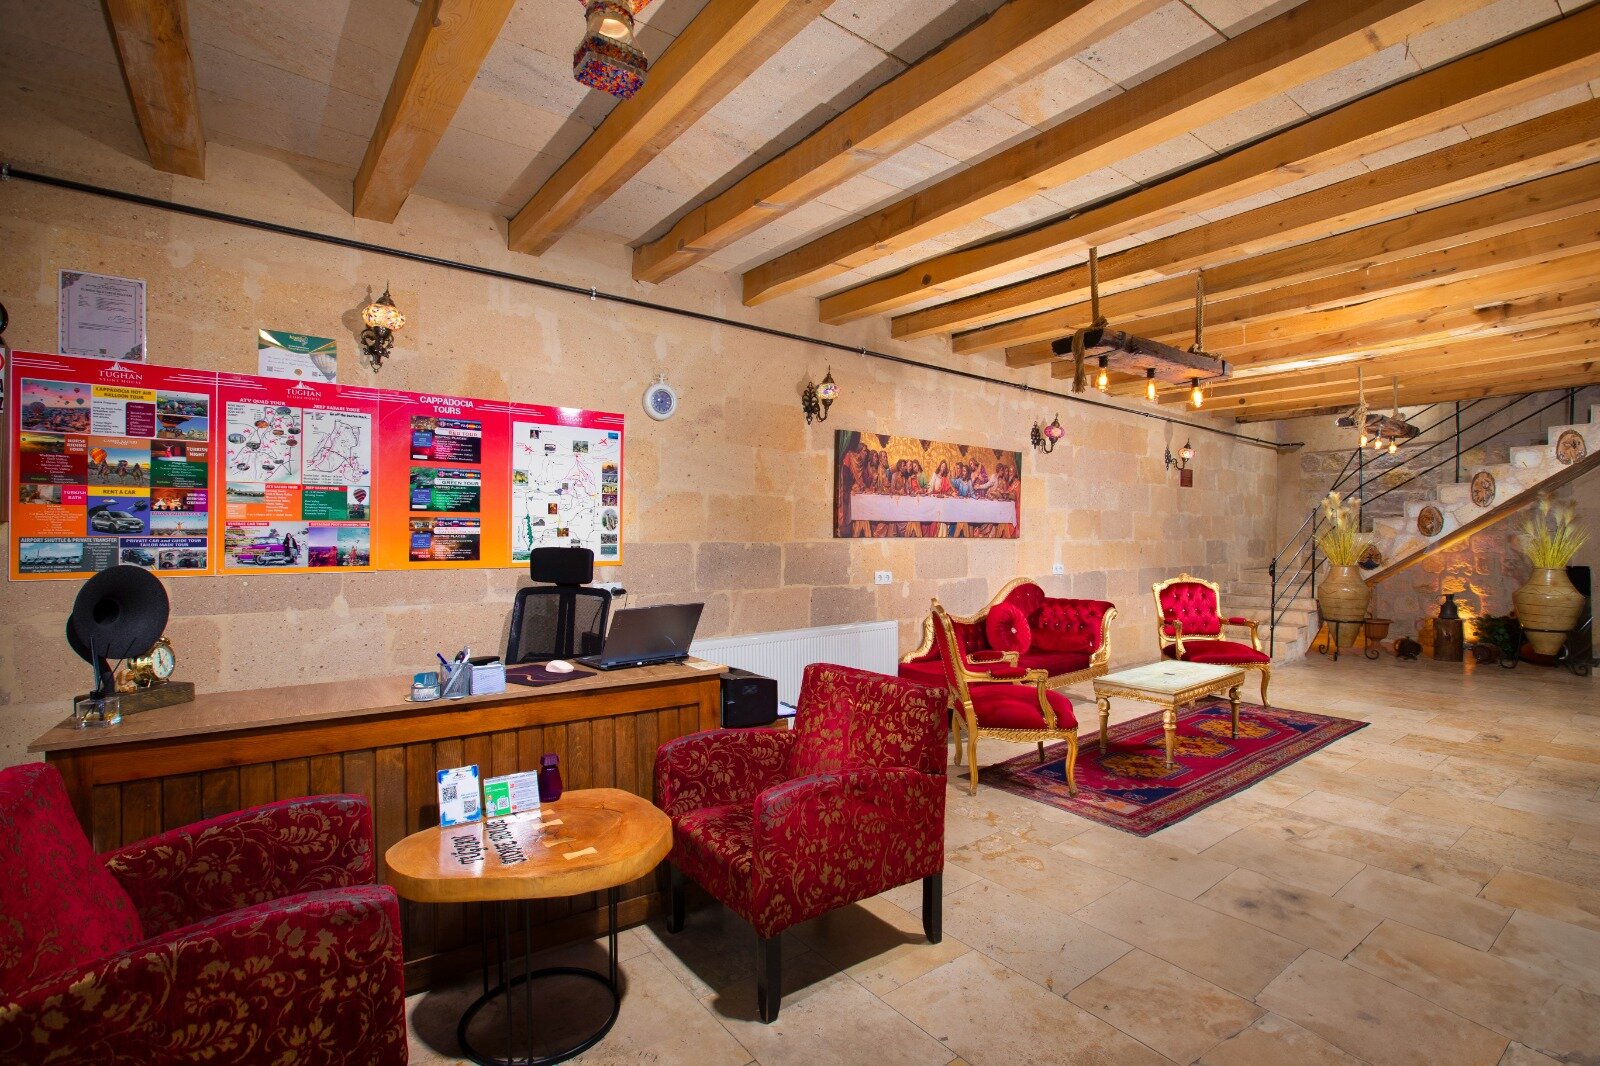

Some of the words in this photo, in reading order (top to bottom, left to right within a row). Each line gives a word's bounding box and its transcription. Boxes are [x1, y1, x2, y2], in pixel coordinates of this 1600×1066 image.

[100, 370, 143, 381] TUGHAN
[286, 388, 322, 398] TUGHAN
[420, 396, 474, 408] CAPPADOCIA
[433, 406, 461, 414] TOURS
